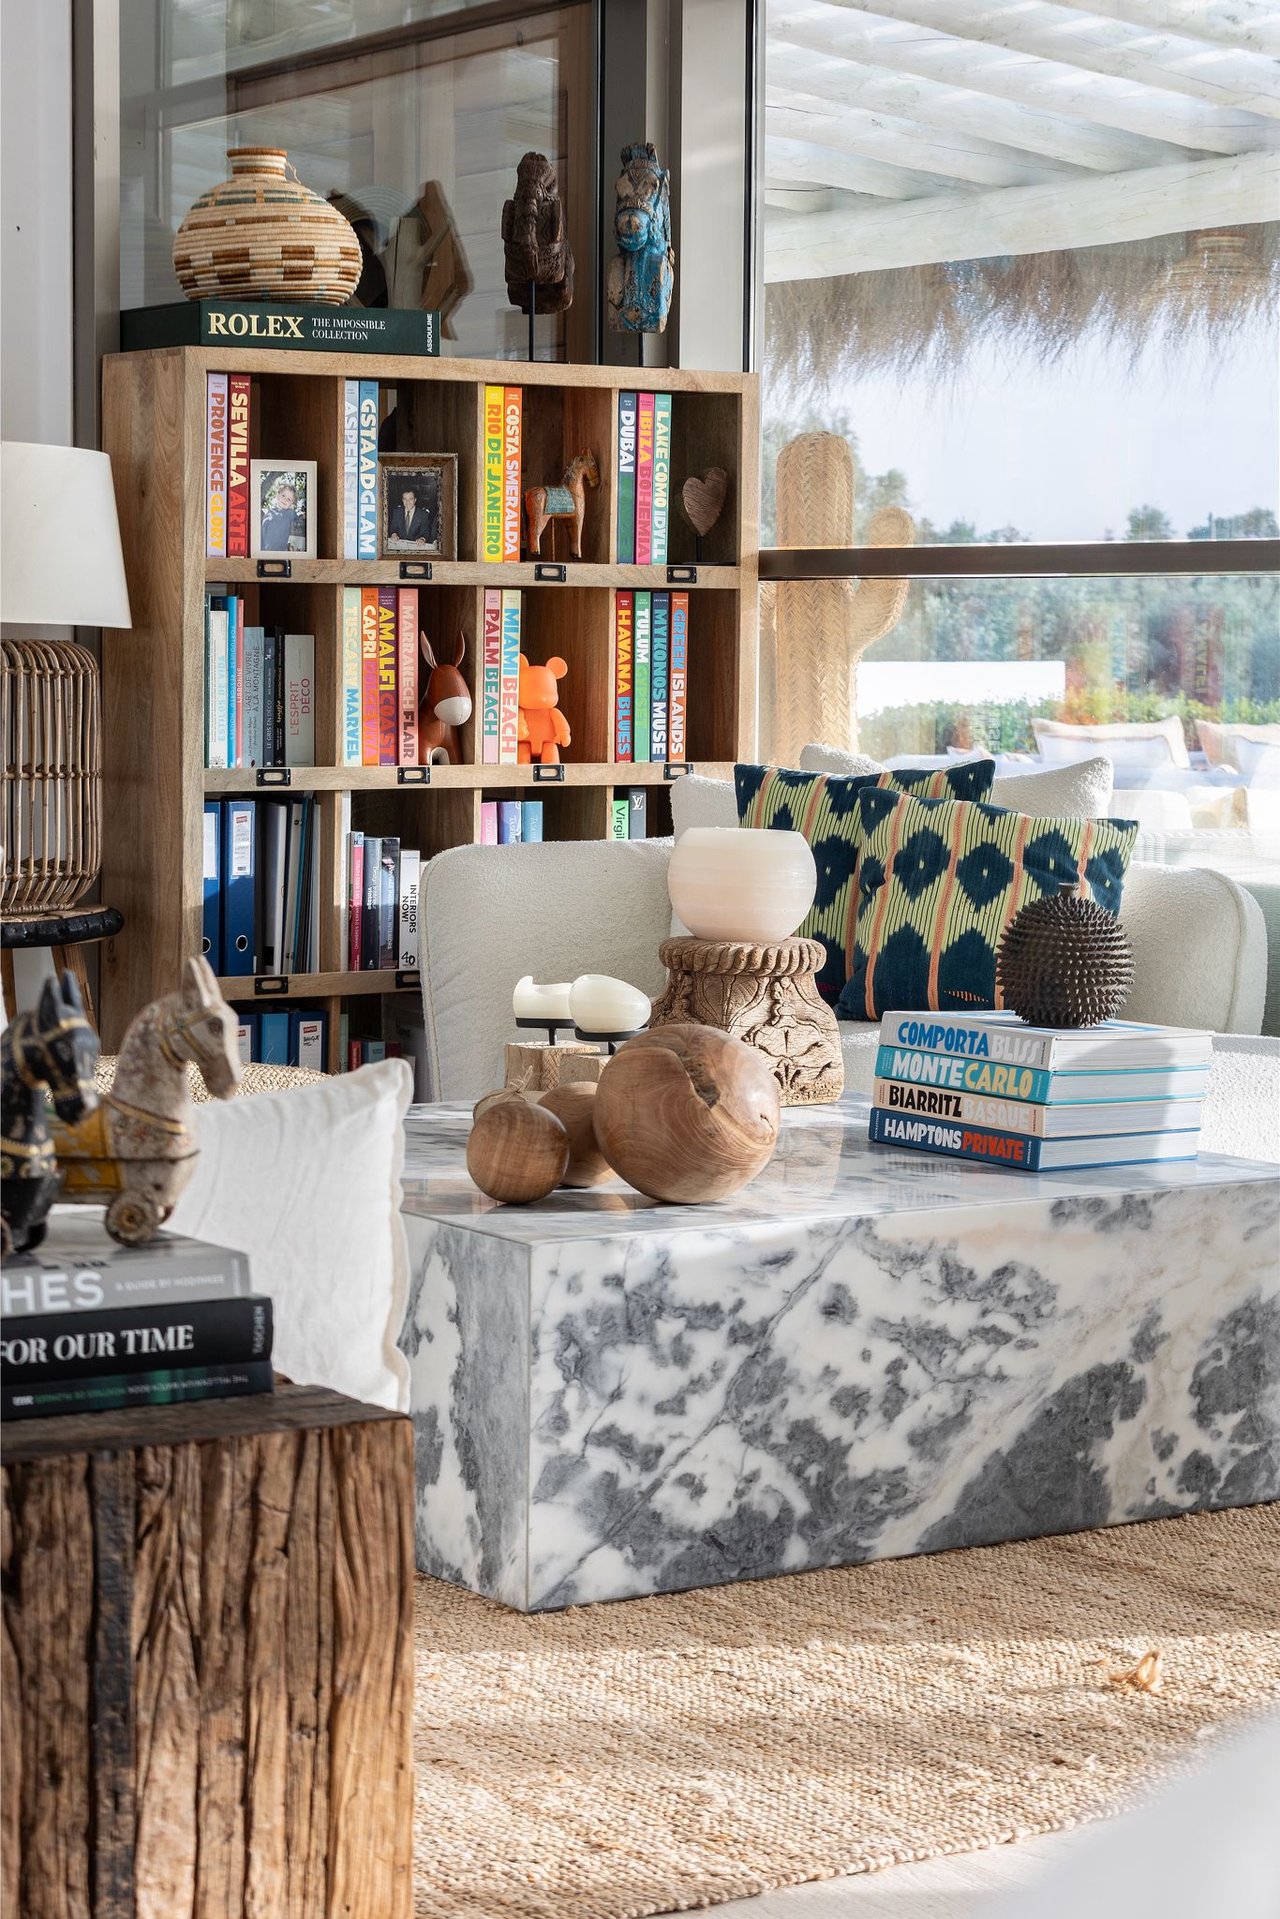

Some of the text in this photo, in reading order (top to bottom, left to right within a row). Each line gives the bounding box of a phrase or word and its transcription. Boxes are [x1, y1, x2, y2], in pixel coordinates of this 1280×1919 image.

[208, 312, 304, 338] ROLEX
[312, 317, 386, 331] THE IMPOSSIBLE
[312, 329, 368, 341] COLLECTION
[210, 392, 225, 491] PROVENCE
[230, 392, 248, 488] SEVILLA
[344, 400, 358, 472] ASPEN
[360, 398, 376, 490] GSTAAD
[488, 404, 502, 434] RIO
[506, 404, 520, 456] COSTA
[620, 410, 635, 472] DUBAI
[639, 410, 653, 464] IBIZA
[656, 410, 669, 458] LAKE
[488, 438, 502, 464] DE
[486, 468, 501, 554] JANEIRO
[504, 460, 519, 555] SMERALDA
[637, 466, 652, 558] BOHEMIA
[654, 462, 668, 507] COMO
[210, 493, 224, 550] GLORY
[228, 490, 247, 552] ARTE
[360, 490, 376, 553] GLAM
[653, 510, 667, 560] IDYLL
[363, 604, 376, 658] CAPRI
[379, 606, 396, 691] AMALFI
[485, 608, 500, 664] PALM
[502, 608, 520, 675] MIAMI
[618, 610, 631, 694] HAVANA
[636, 608, 649, 663] TULUM
[652, 609, 668, 700] MYKONOS
[672, 608, 686, 670] GREEK
[218, 655, 226, 742] ESTILOS DE VIDA
[245, 676, 252, 690] DE
[252, 694, 260, 705] LA
[290, 681, 300, 736] L'ESPRIT
[299, 678, 310, 714] DÉCO
[402, 606, 415, 759] MARRAKECH FLAIR
[484, 668, 499, 736] BEACH
[266, 718, 272, 726] EN
[346, 688, 359, 760] MARVEL
[364, 719, 378, 759] VITA
[379, 692, 395, 757] COAST
[502, 678, 518, 754] BEACH
[618, 697, 631, 754] BLUES
[652, 702, 667, 754] MUSE
[671, 673, 684, 754] ISLANDS
[614, 806, 626, 840] Virgil
[402, 896, 410, 922] NOW!
[408, 884, 417, 933] INTERIORS
[898, 1021, 1041, 1064] COMPORTA BLISS
[891, 1050, 964, 1088] MONTE
[965, 1062, 1033, 1098] CARLO
[888, 1084, 962, 1118] BIARRITZ
[963, 1098, 1030, 1130] BASQUE
[884, 1118, 1024, 1161] HAMPTONS PRIVATE
[2, 1270, 104, 1312] HES
[54, 1331, 116, 1361] OUR
[121, 1324, 194, 1354] TIME
